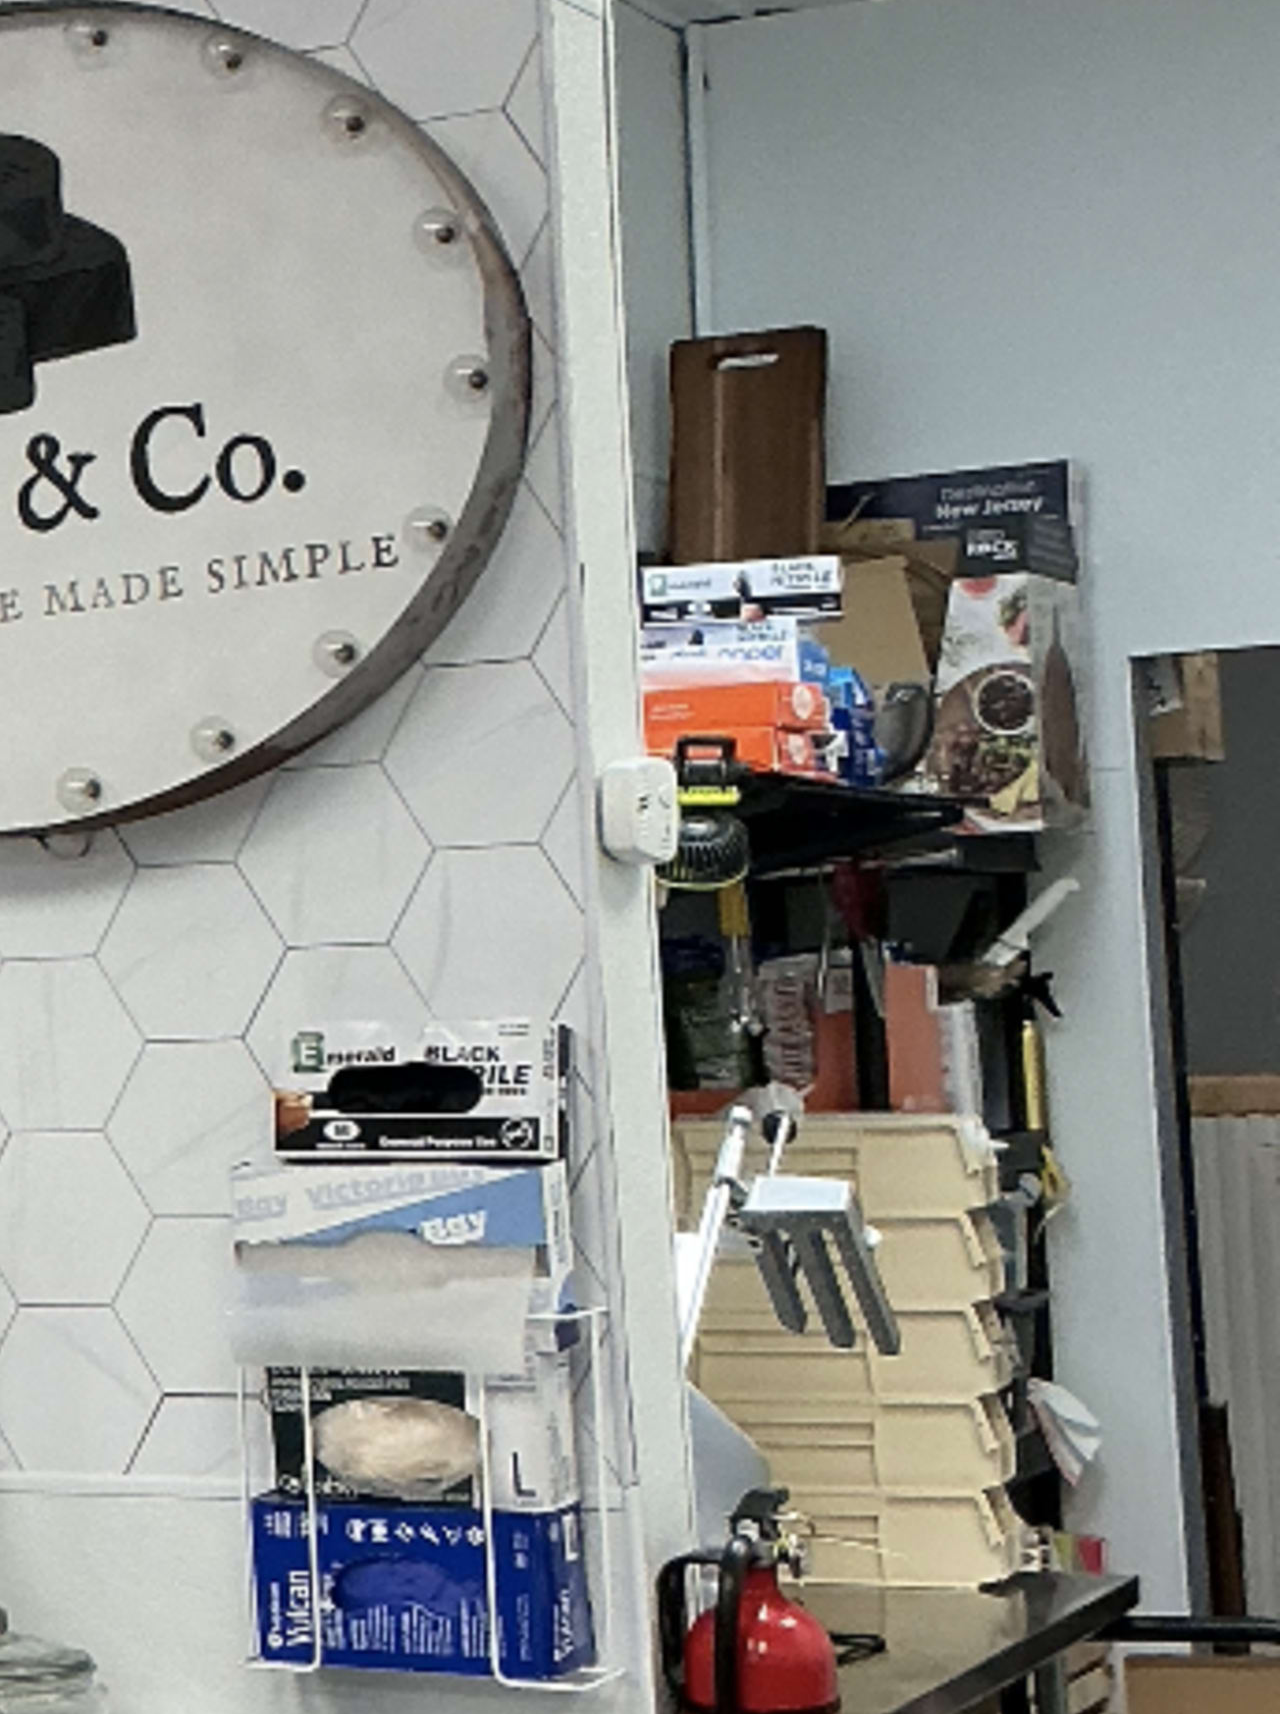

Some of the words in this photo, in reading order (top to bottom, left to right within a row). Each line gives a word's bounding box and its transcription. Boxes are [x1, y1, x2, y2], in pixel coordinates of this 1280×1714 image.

[17, 433, 100, 532] &
[43, 566, 184, 616] MADE
[207, 534, 400, 594] SIMPLE
[423, 1045, 501, 1063] BLACK
[305, 1173, 425, 1210] Victoria
[286, 1570, 311, 1647] Vulcan
